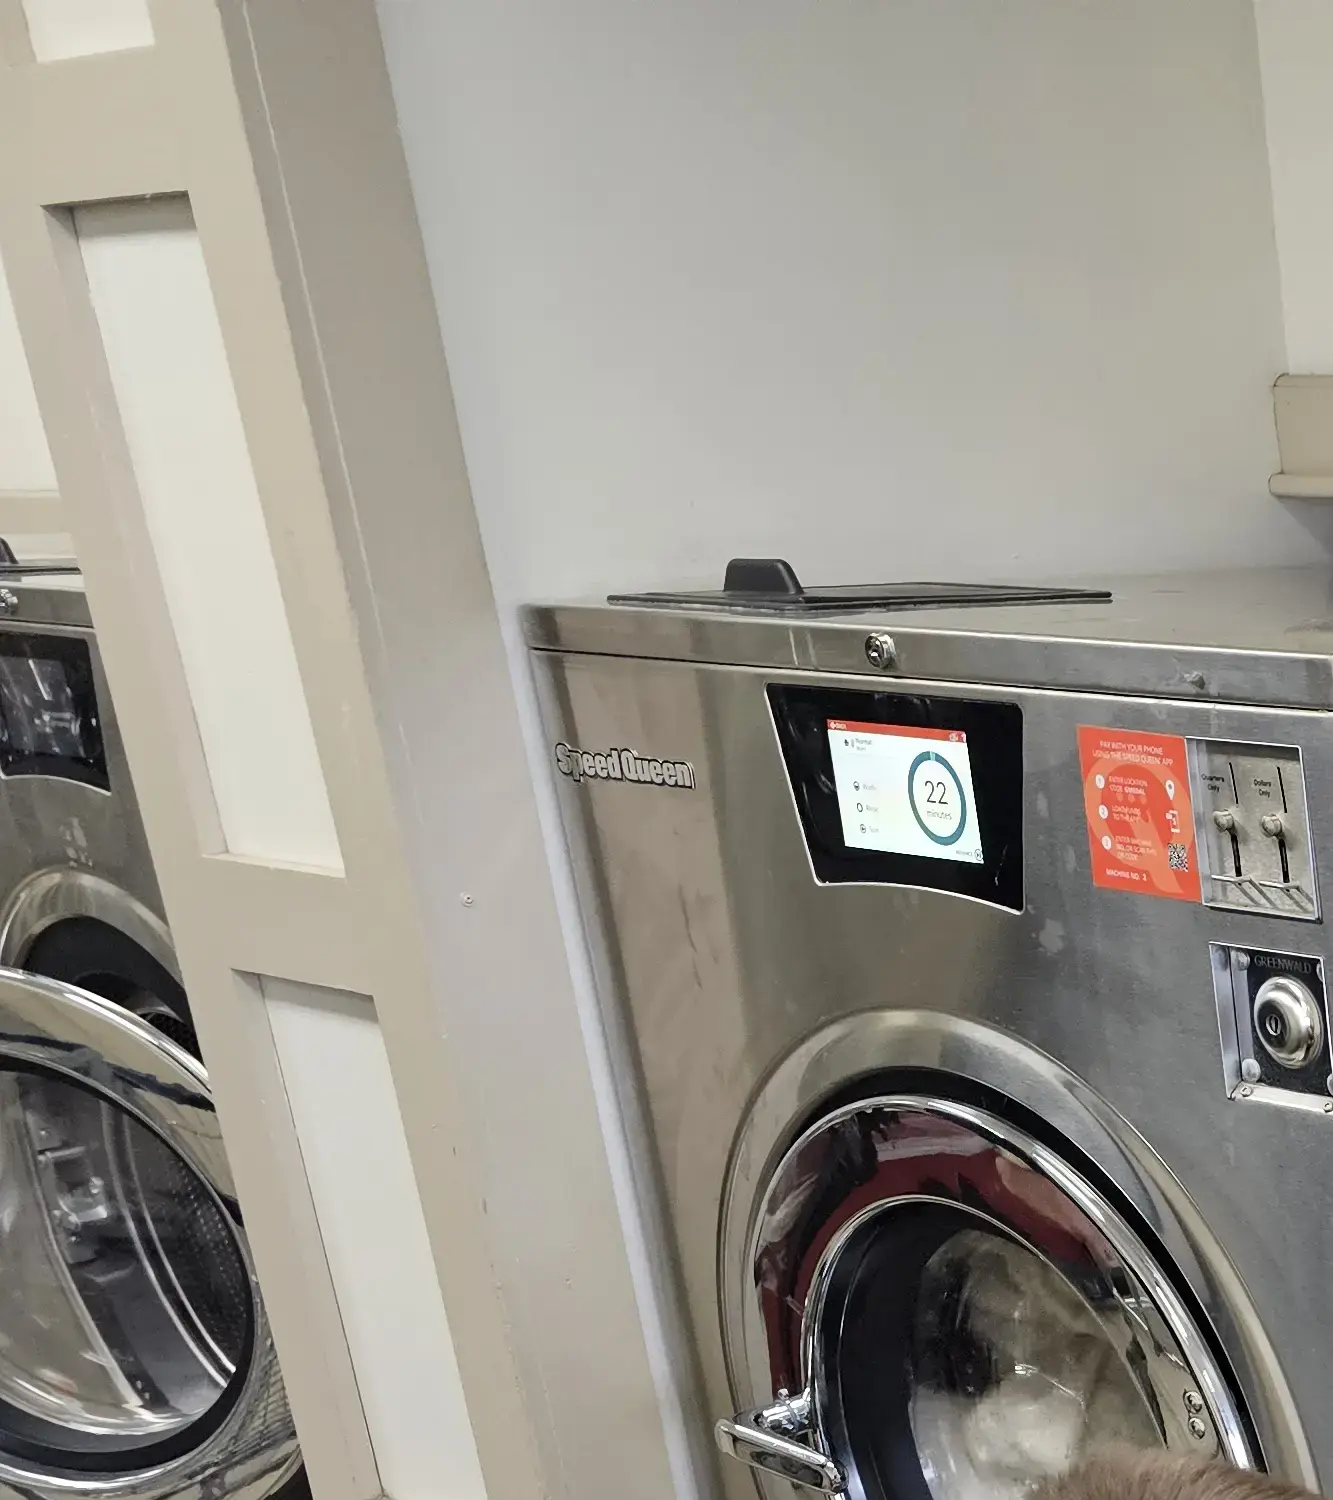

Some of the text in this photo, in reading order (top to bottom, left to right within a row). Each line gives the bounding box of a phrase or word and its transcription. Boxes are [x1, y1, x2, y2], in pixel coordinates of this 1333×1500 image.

[1126, 744, 1142, 752] YOUR
[1144, 746, 1163, 755] PHONE
[555, 742, 695, 789] Speed Queen
[1200, 774, 1224, 782] Quarters
[1254, 778, 1272, 786] Dollars
[924, 780, 949, 804] 22
[1208, 784, 1220, 792] Only
[1258, 789, 1270, 798] Only
[926, 809, 952, 821] minutes
[1254, 954, 1312, 974] GREENWALD
